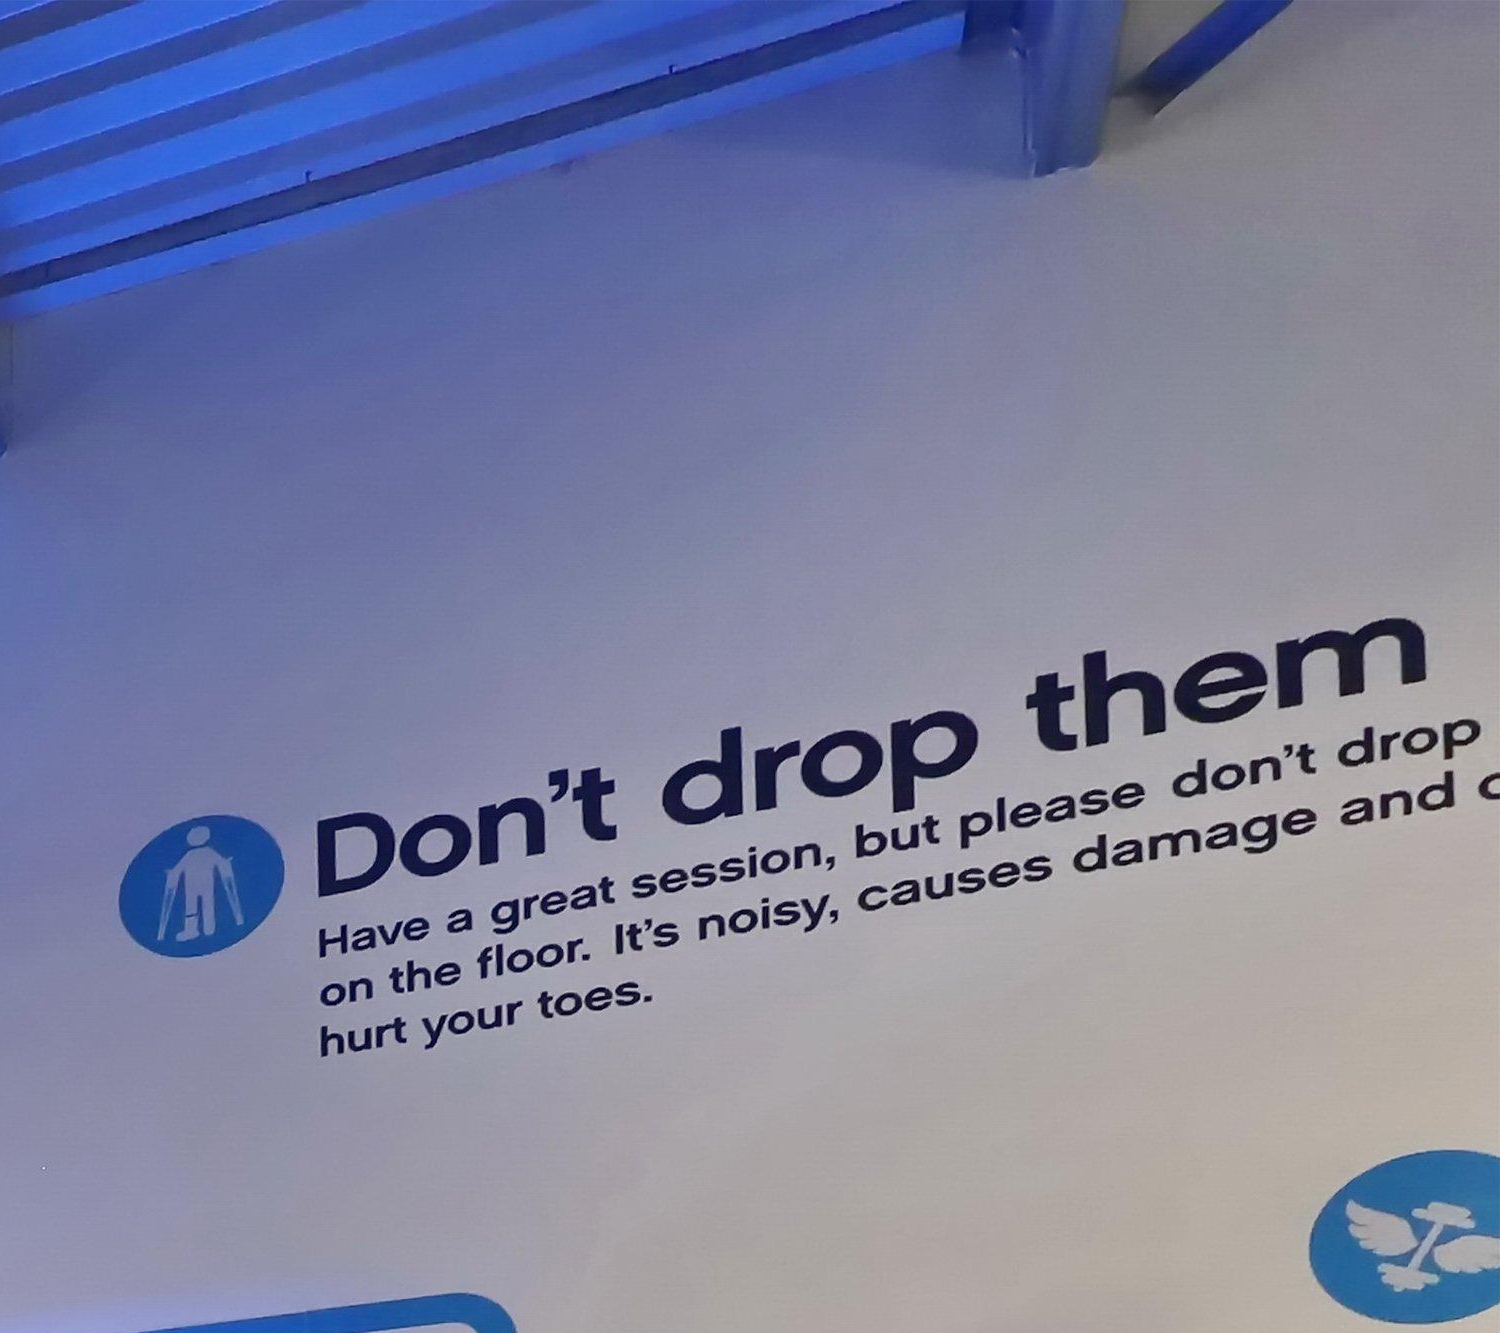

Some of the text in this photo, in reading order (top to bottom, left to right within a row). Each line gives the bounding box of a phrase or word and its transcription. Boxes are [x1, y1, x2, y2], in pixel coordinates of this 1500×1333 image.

[662, 711, 979, 826] drop
[1026, 617, 1427, 752] them
[318, 916, 430, 958] Have
[447, 908, 474, 934] a
[490, 876, 616, 934] great
[631, 841, 836, 900] session,
[855, 814, 940, 859] but
[960, 783, 1146, 848] please
[1337, 719, 1481, 767] drop
[319, 972, 374, 1006] on
[389, 960, 462, 995] the
[477, 937, 592, 979] floor.
[698, 894, 840, 941] noisy,
[858, 854, 1053, 912] causes
[1073, 808, 1318, 872] damage
[1340, 771, 1456, 826] and
[319, 980, 653, 1057] hurt your toes.
